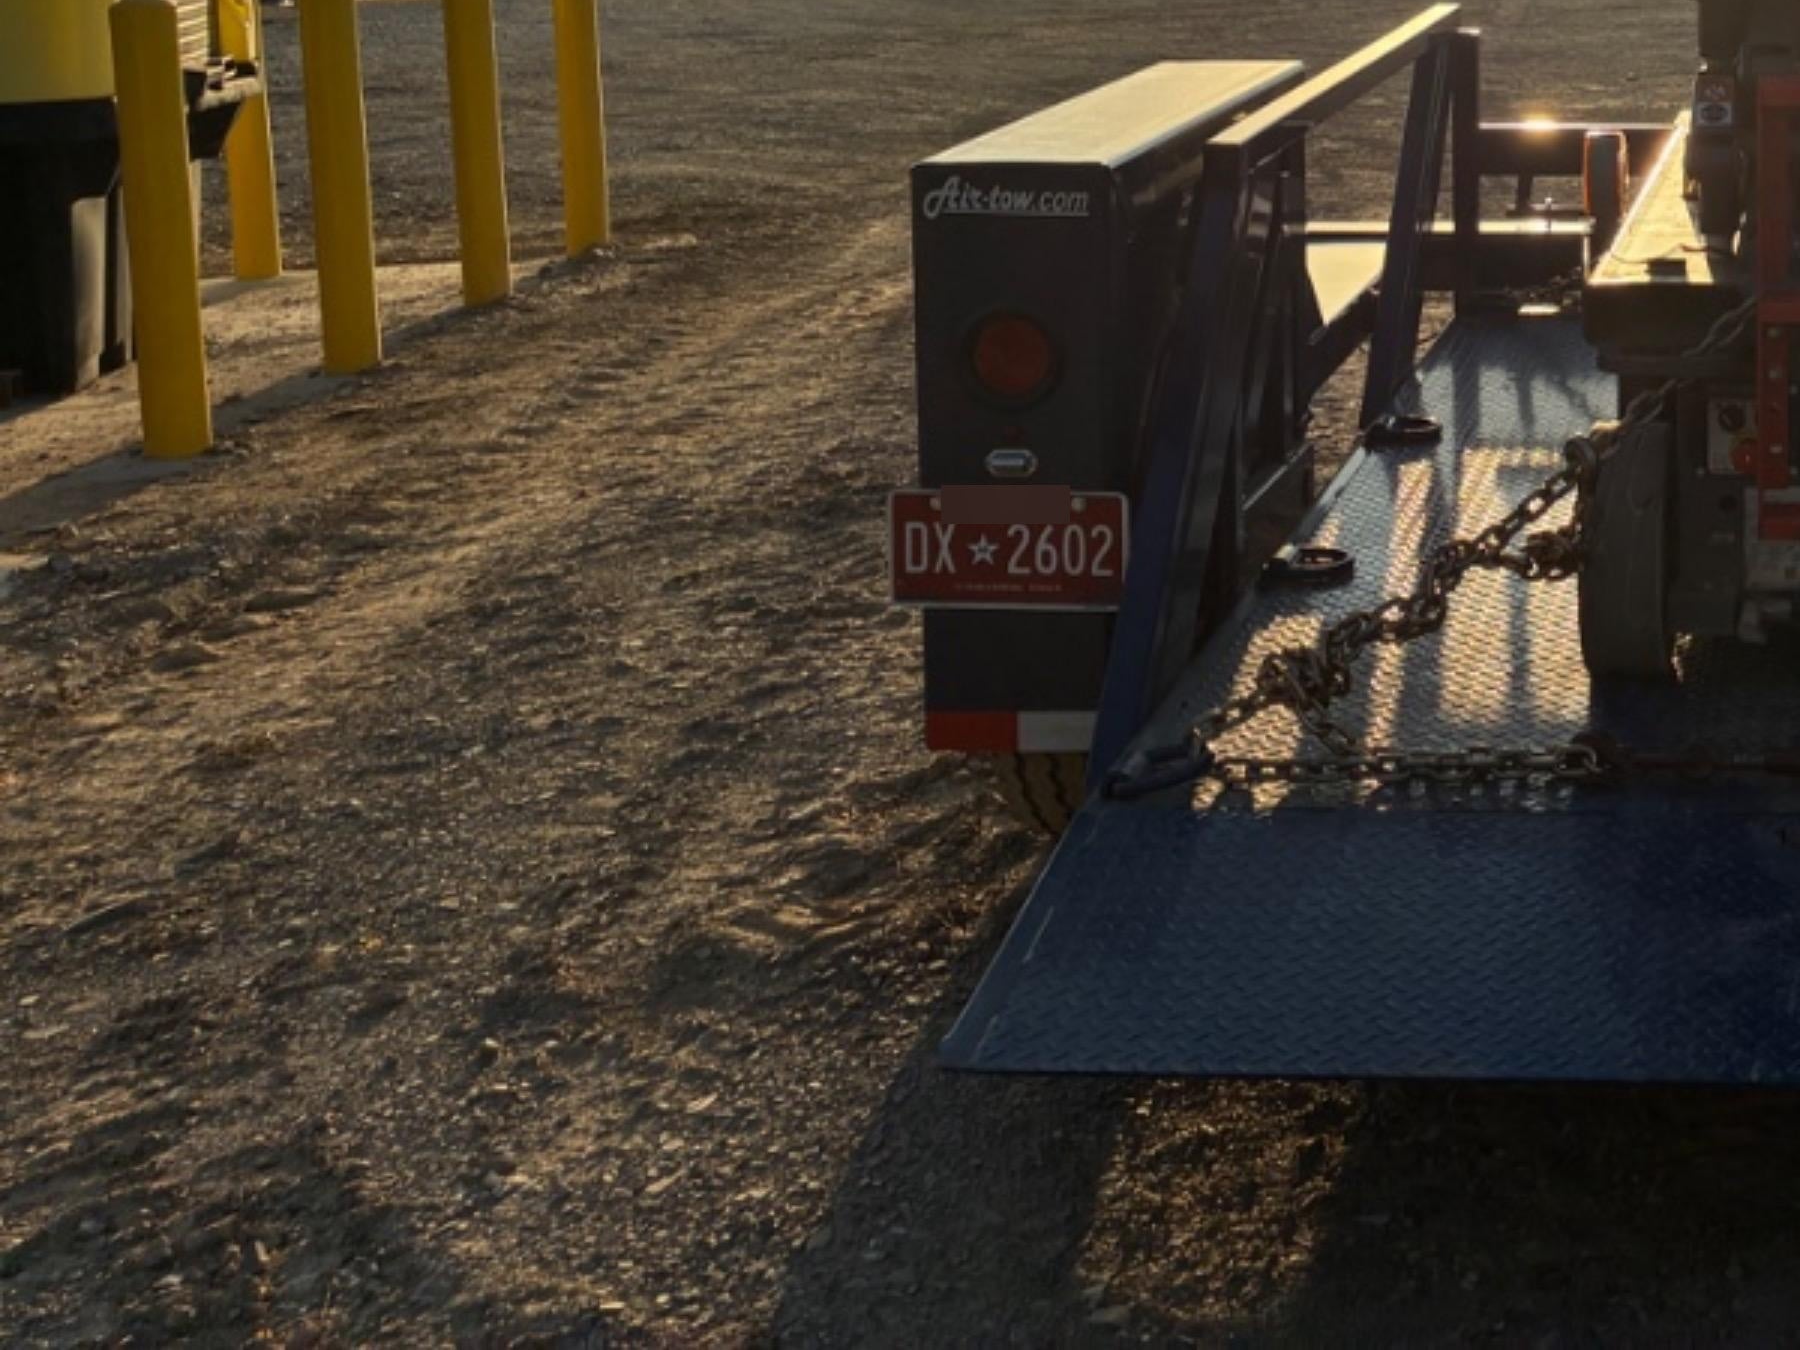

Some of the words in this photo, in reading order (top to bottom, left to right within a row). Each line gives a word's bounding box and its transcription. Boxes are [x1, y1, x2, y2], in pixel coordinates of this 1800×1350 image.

[922, 175, 1089, 220] Air-tow.com
[904, 521, 957, 575] DX
[1006, 523, 1115, 578] 2602
